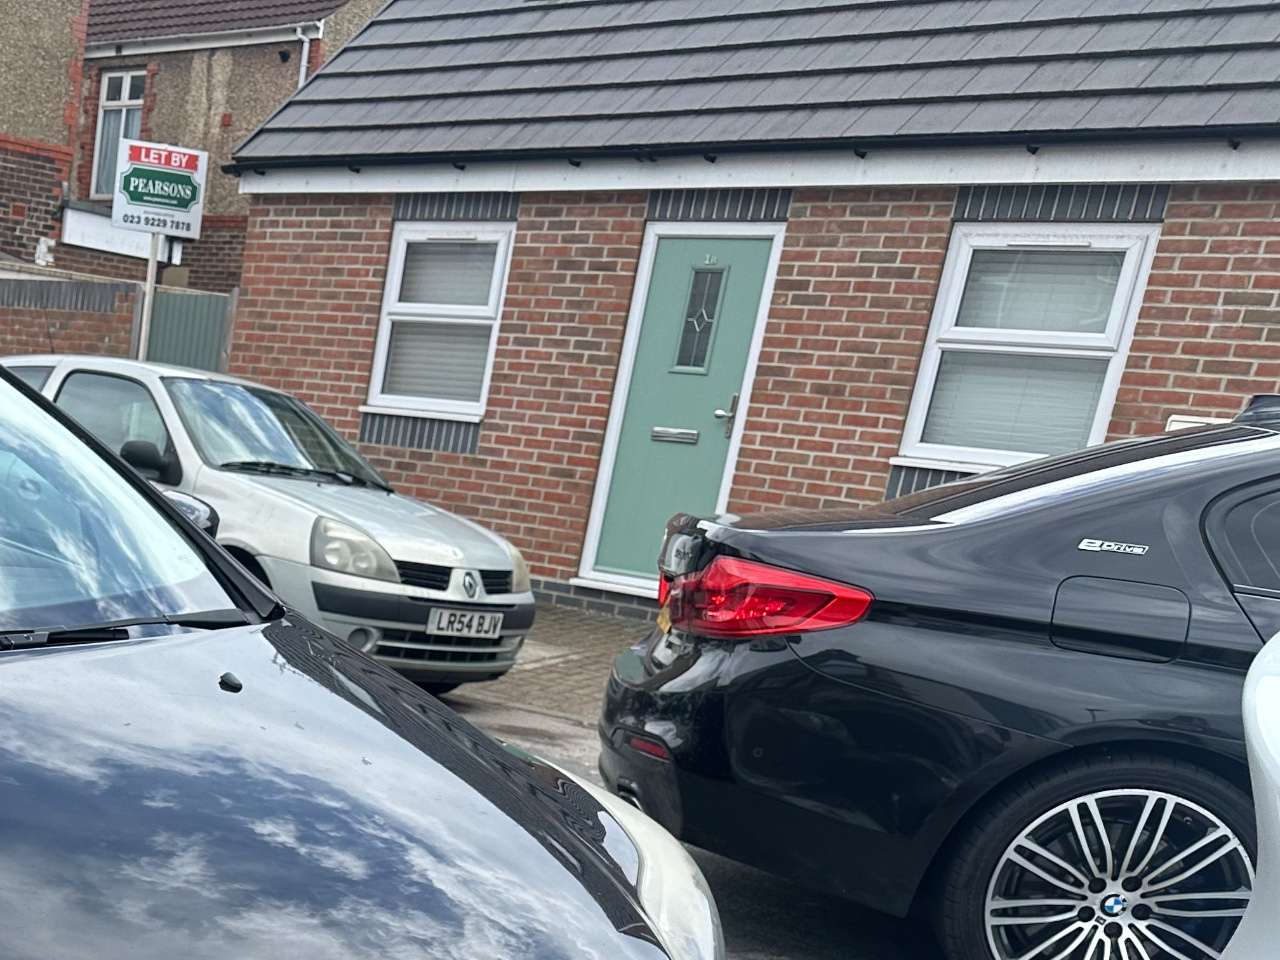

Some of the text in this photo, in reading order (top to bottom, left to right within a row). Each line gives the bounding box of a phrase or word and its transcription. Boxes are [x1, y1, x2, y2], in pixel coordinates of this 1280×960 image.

[140, 148, 190, 168] LET BY
[129, 177, 193, 199] PEARSONS
[122, 214, 141, 225] 023
[436, 611, 473, 633] LR54
